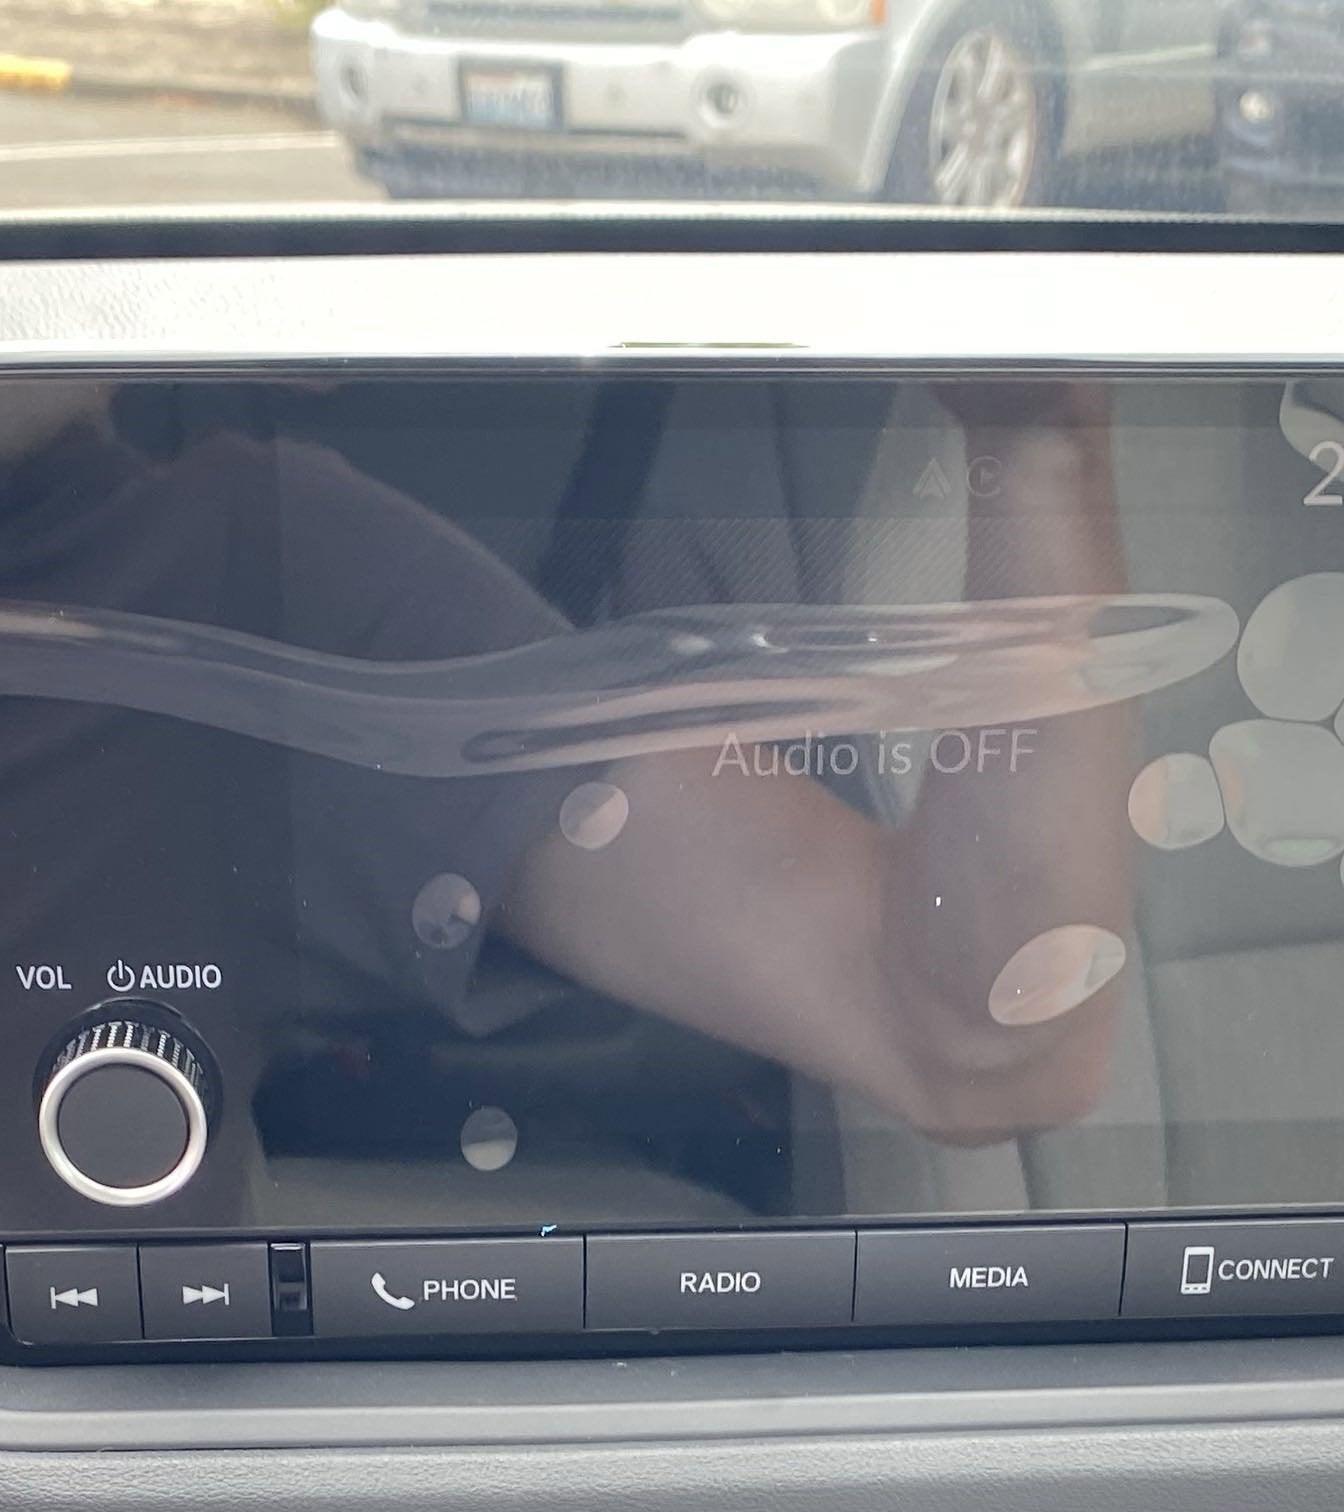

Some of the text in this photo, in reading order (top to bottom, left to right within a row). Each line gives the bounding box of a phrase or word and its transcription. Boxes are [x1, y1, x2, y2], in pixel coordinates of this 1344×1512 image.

[711, 729, 1038, 777] Audio is OFF
[16, 966, 72, 990] VOL
[139, 964, 222, 989] AUDIO
[949, 1266, 1029, 1290] MEDIA
[1217, 1257, 1335, 1281] CONNECT
[422, 1278, 516, 1302] PHONE
[680, 1272, 761, 1294] RADIO
